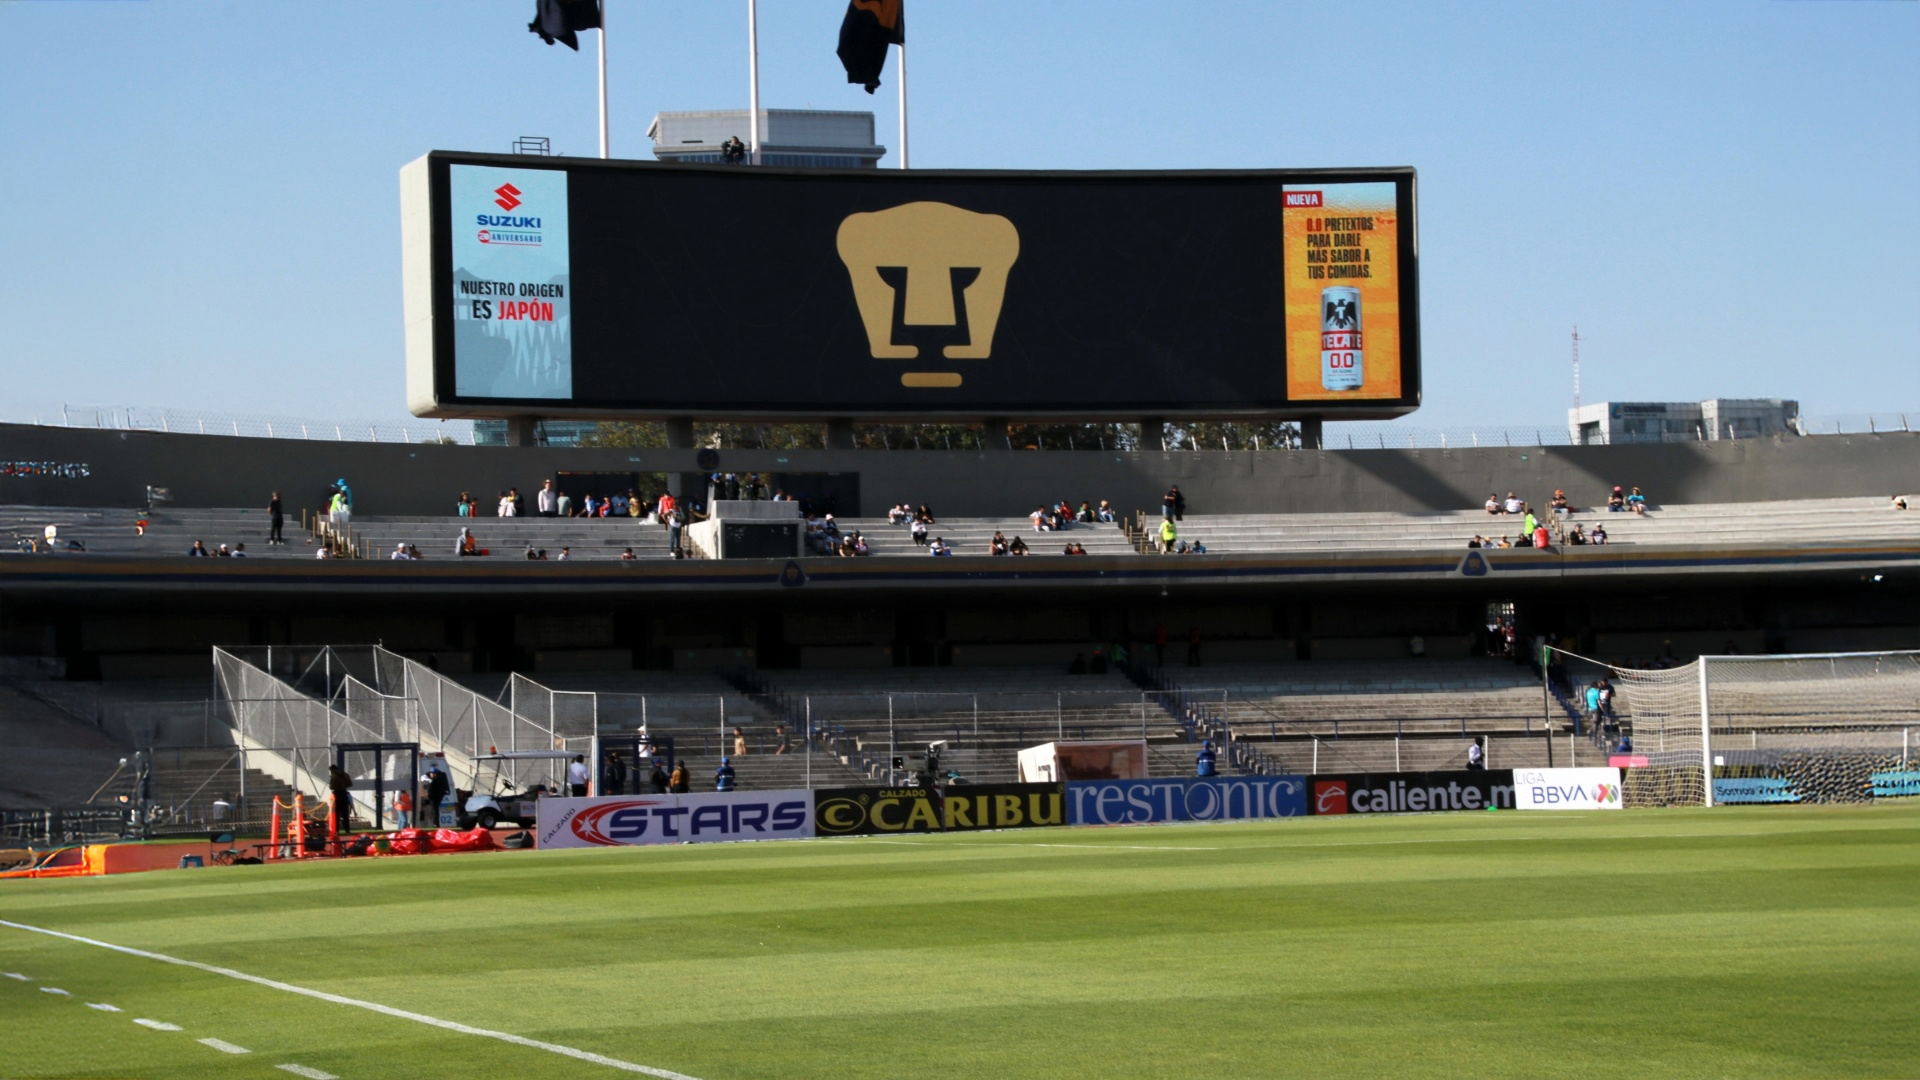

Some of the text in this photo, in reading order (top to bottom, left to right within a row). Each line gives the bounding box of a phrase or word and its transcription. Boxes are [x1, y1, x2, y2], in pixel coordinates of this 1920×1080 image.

[1287, 193, 1319, 206] NUEVA
[477, 214, 541, 229] SUZUKI
[1306, 217, 1373, 232] 0.0 PRETEXTOS
[492, 233, 542, 243] ANIVERSARIO
[1307, 233, 1361, 248] PARA DARLE
[1331, 249, 1362, 263] SABOR
[1364, 249, 1370, 262] A
[1308, 264, 1372, 279] TUS COMIDAS.
[460, 280, 564, 299] NUESTRO ORIGEN
[472, 298, 554, 322] ES JAPÓN
[1321, 333, 1362, 349] TECATE
[1330, 352, 1354, 369] 0.0
[1515, 772, 1546, 785] LIGA
[879, 789, 926, 798] CALZADO
[1532, 785, 1588, 804] BBVA
[1716, 786, 1755, 796] Somos
[440, 815, 452, 824] 02
[610, 800, 806, 839] STARS
[870, 793, 1063, 831] CARIBU
[542, 807, 576, 844] CALZADO
